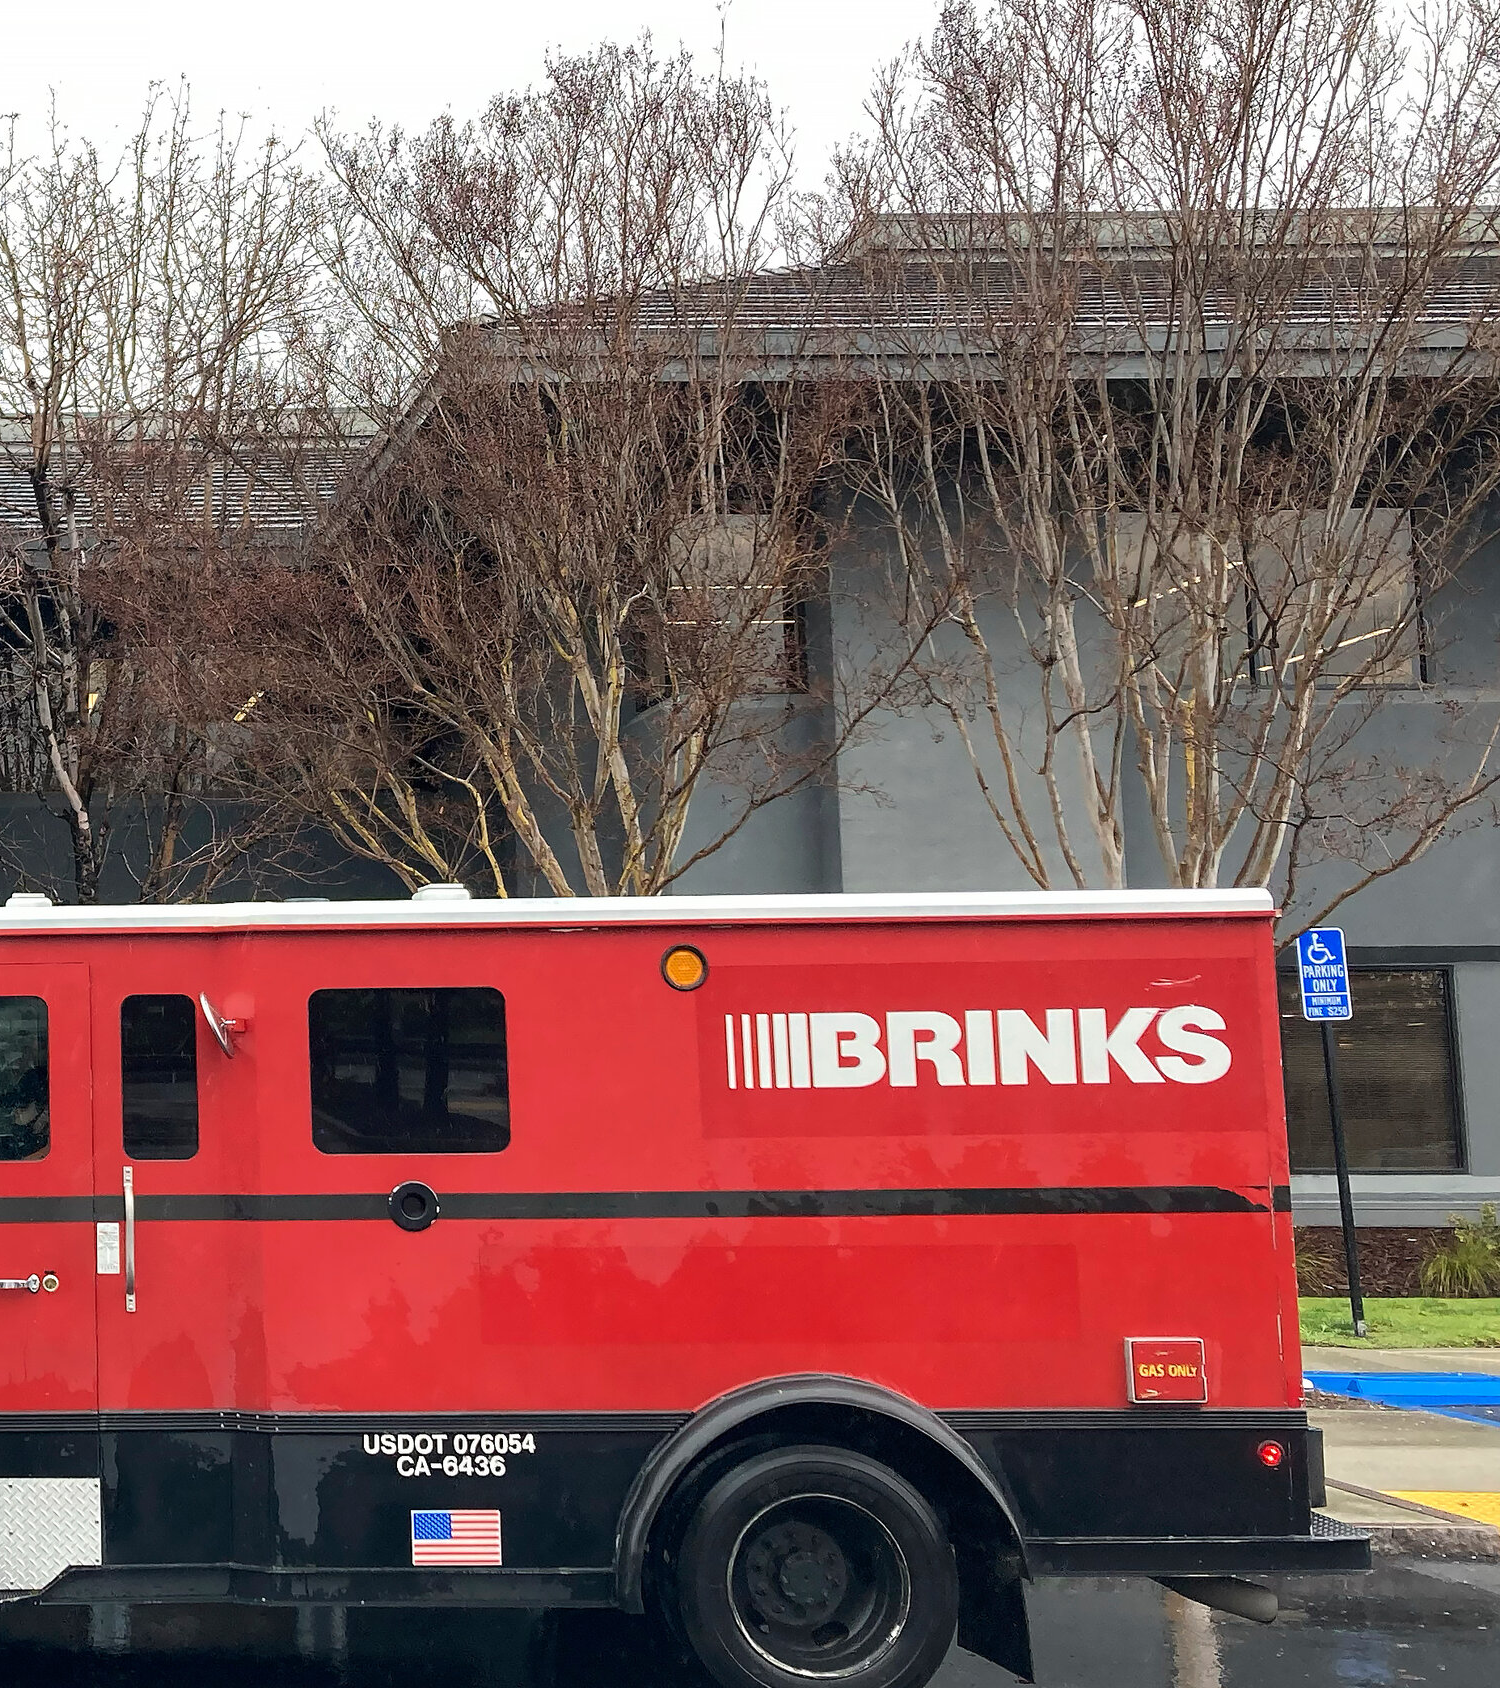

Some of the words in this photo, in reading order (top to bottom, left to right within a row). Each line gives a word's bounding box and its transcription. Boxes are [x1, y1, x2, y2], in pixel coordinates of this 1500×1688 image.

[1303, 965, 1344, 978] PARKING
[1312, 979, 1337, 992] ONLY
[1312, 996, 1341, 1006] MINIMUM
[1308, 1007, 1323, 1016] FINE
[1327, 1006, 1348, 1016] $250
[808, 1004, 1233, 1089] BRINKS
[1138, 1364, 1165, 1378] GAS
[1168, 1364, 1197, 1378] ONLY
[363, 1434, 448, 1454] USDOT
[453, 1433, 536, 1454] 076054
[396, 1456, 506, 1477] CA-6436
